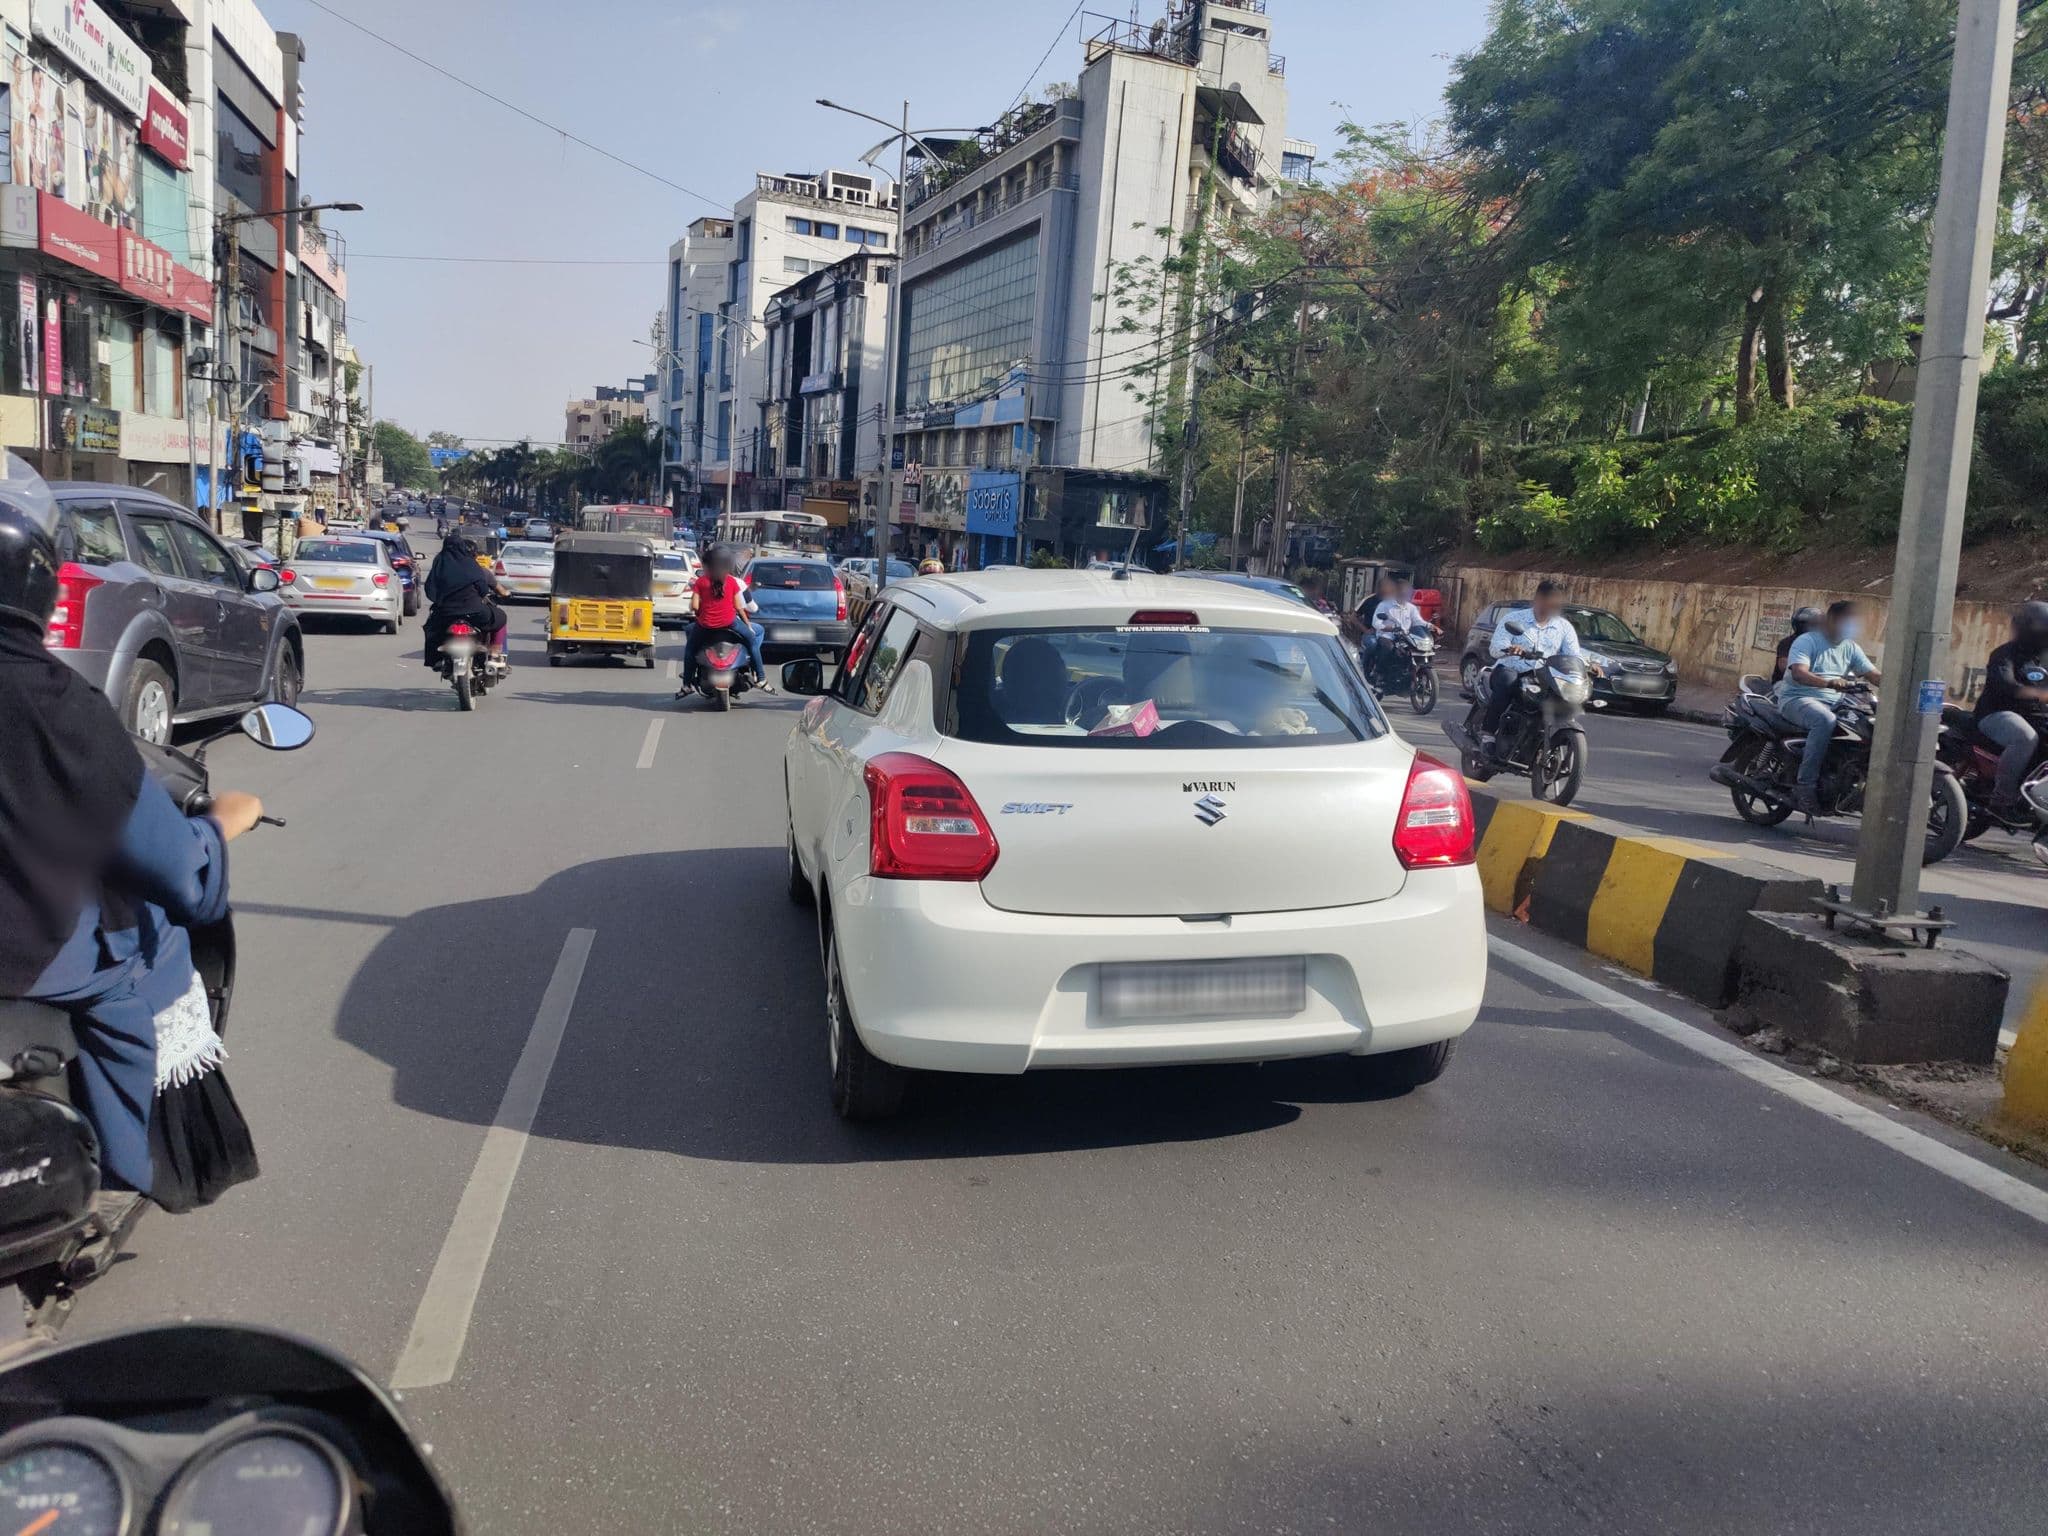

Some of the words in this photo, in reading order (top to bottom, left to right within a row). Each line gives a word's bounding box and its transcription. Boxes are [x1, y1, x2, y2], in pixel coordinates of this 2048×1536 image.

[973, 488, 1010, 510] Saberi's
[1193, 781, 1236, 792] VARUN
[1000, 802, 1073, 815] SWIFT
